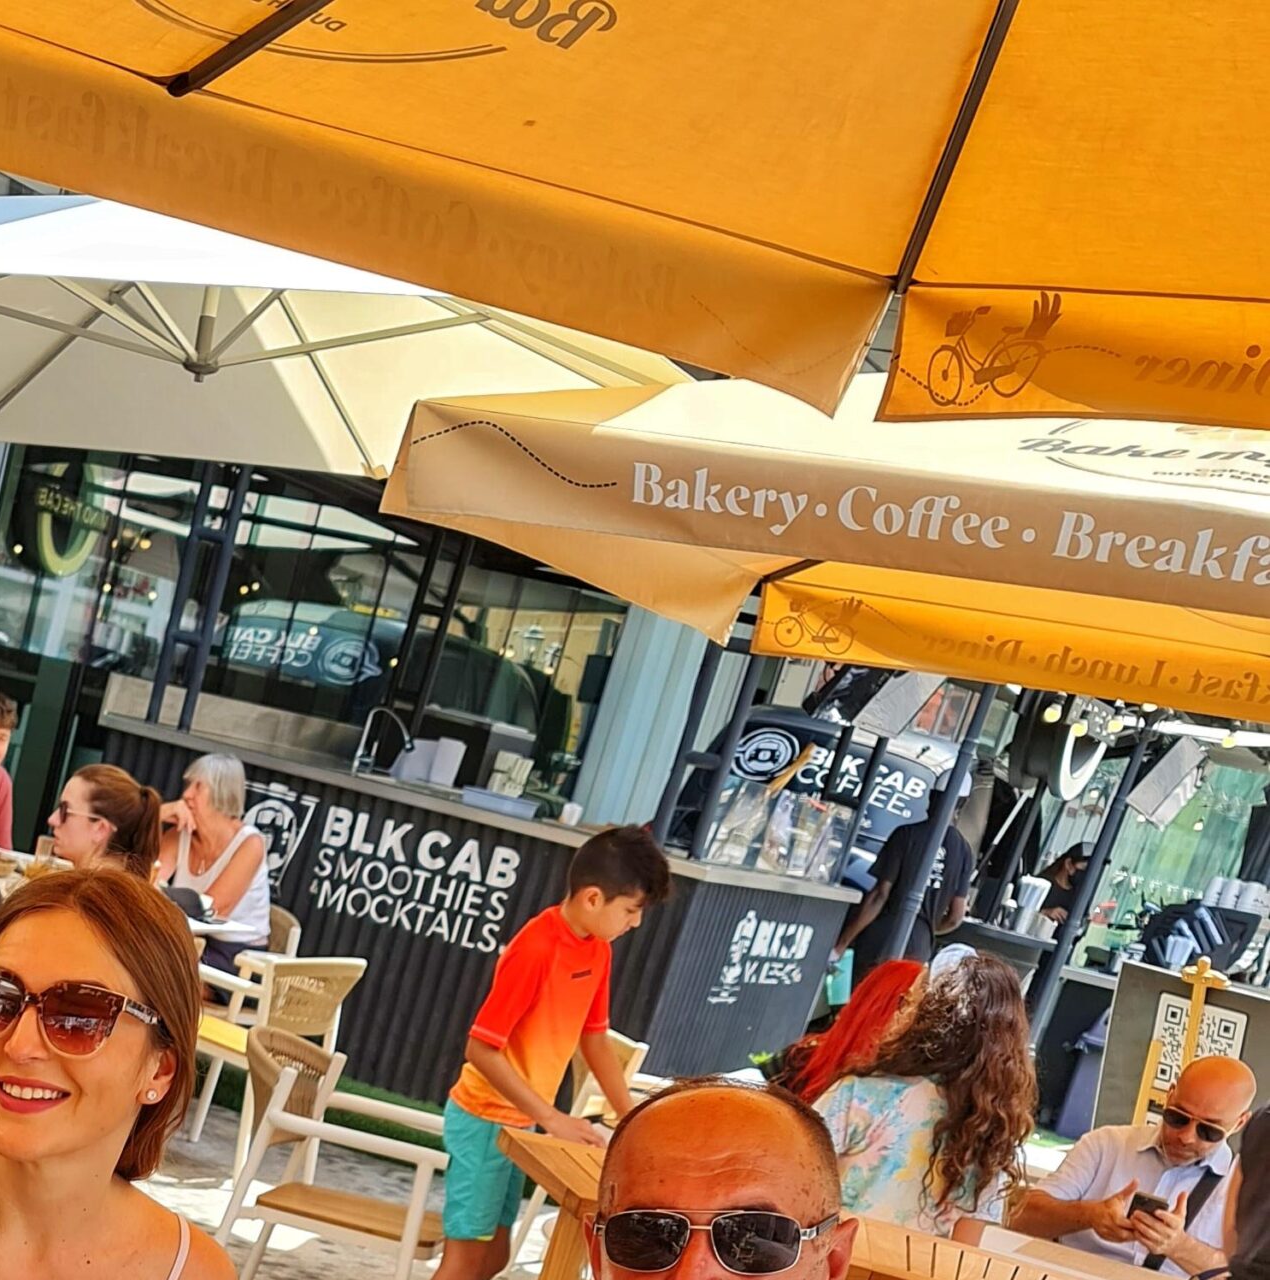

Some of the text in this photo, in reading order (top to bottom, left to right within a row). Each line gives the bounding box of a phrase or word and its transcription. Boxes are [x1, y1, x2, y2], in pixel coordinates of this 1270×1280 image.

[1018, 438, 1190, 458] Bake
[631, 461, 808, 537] Bakery
[837, 485, 1010, 549] Coffee
[314, 847, 509, 922] SMOOTHIES
[321, 805, 521, 889] BLK CAB
